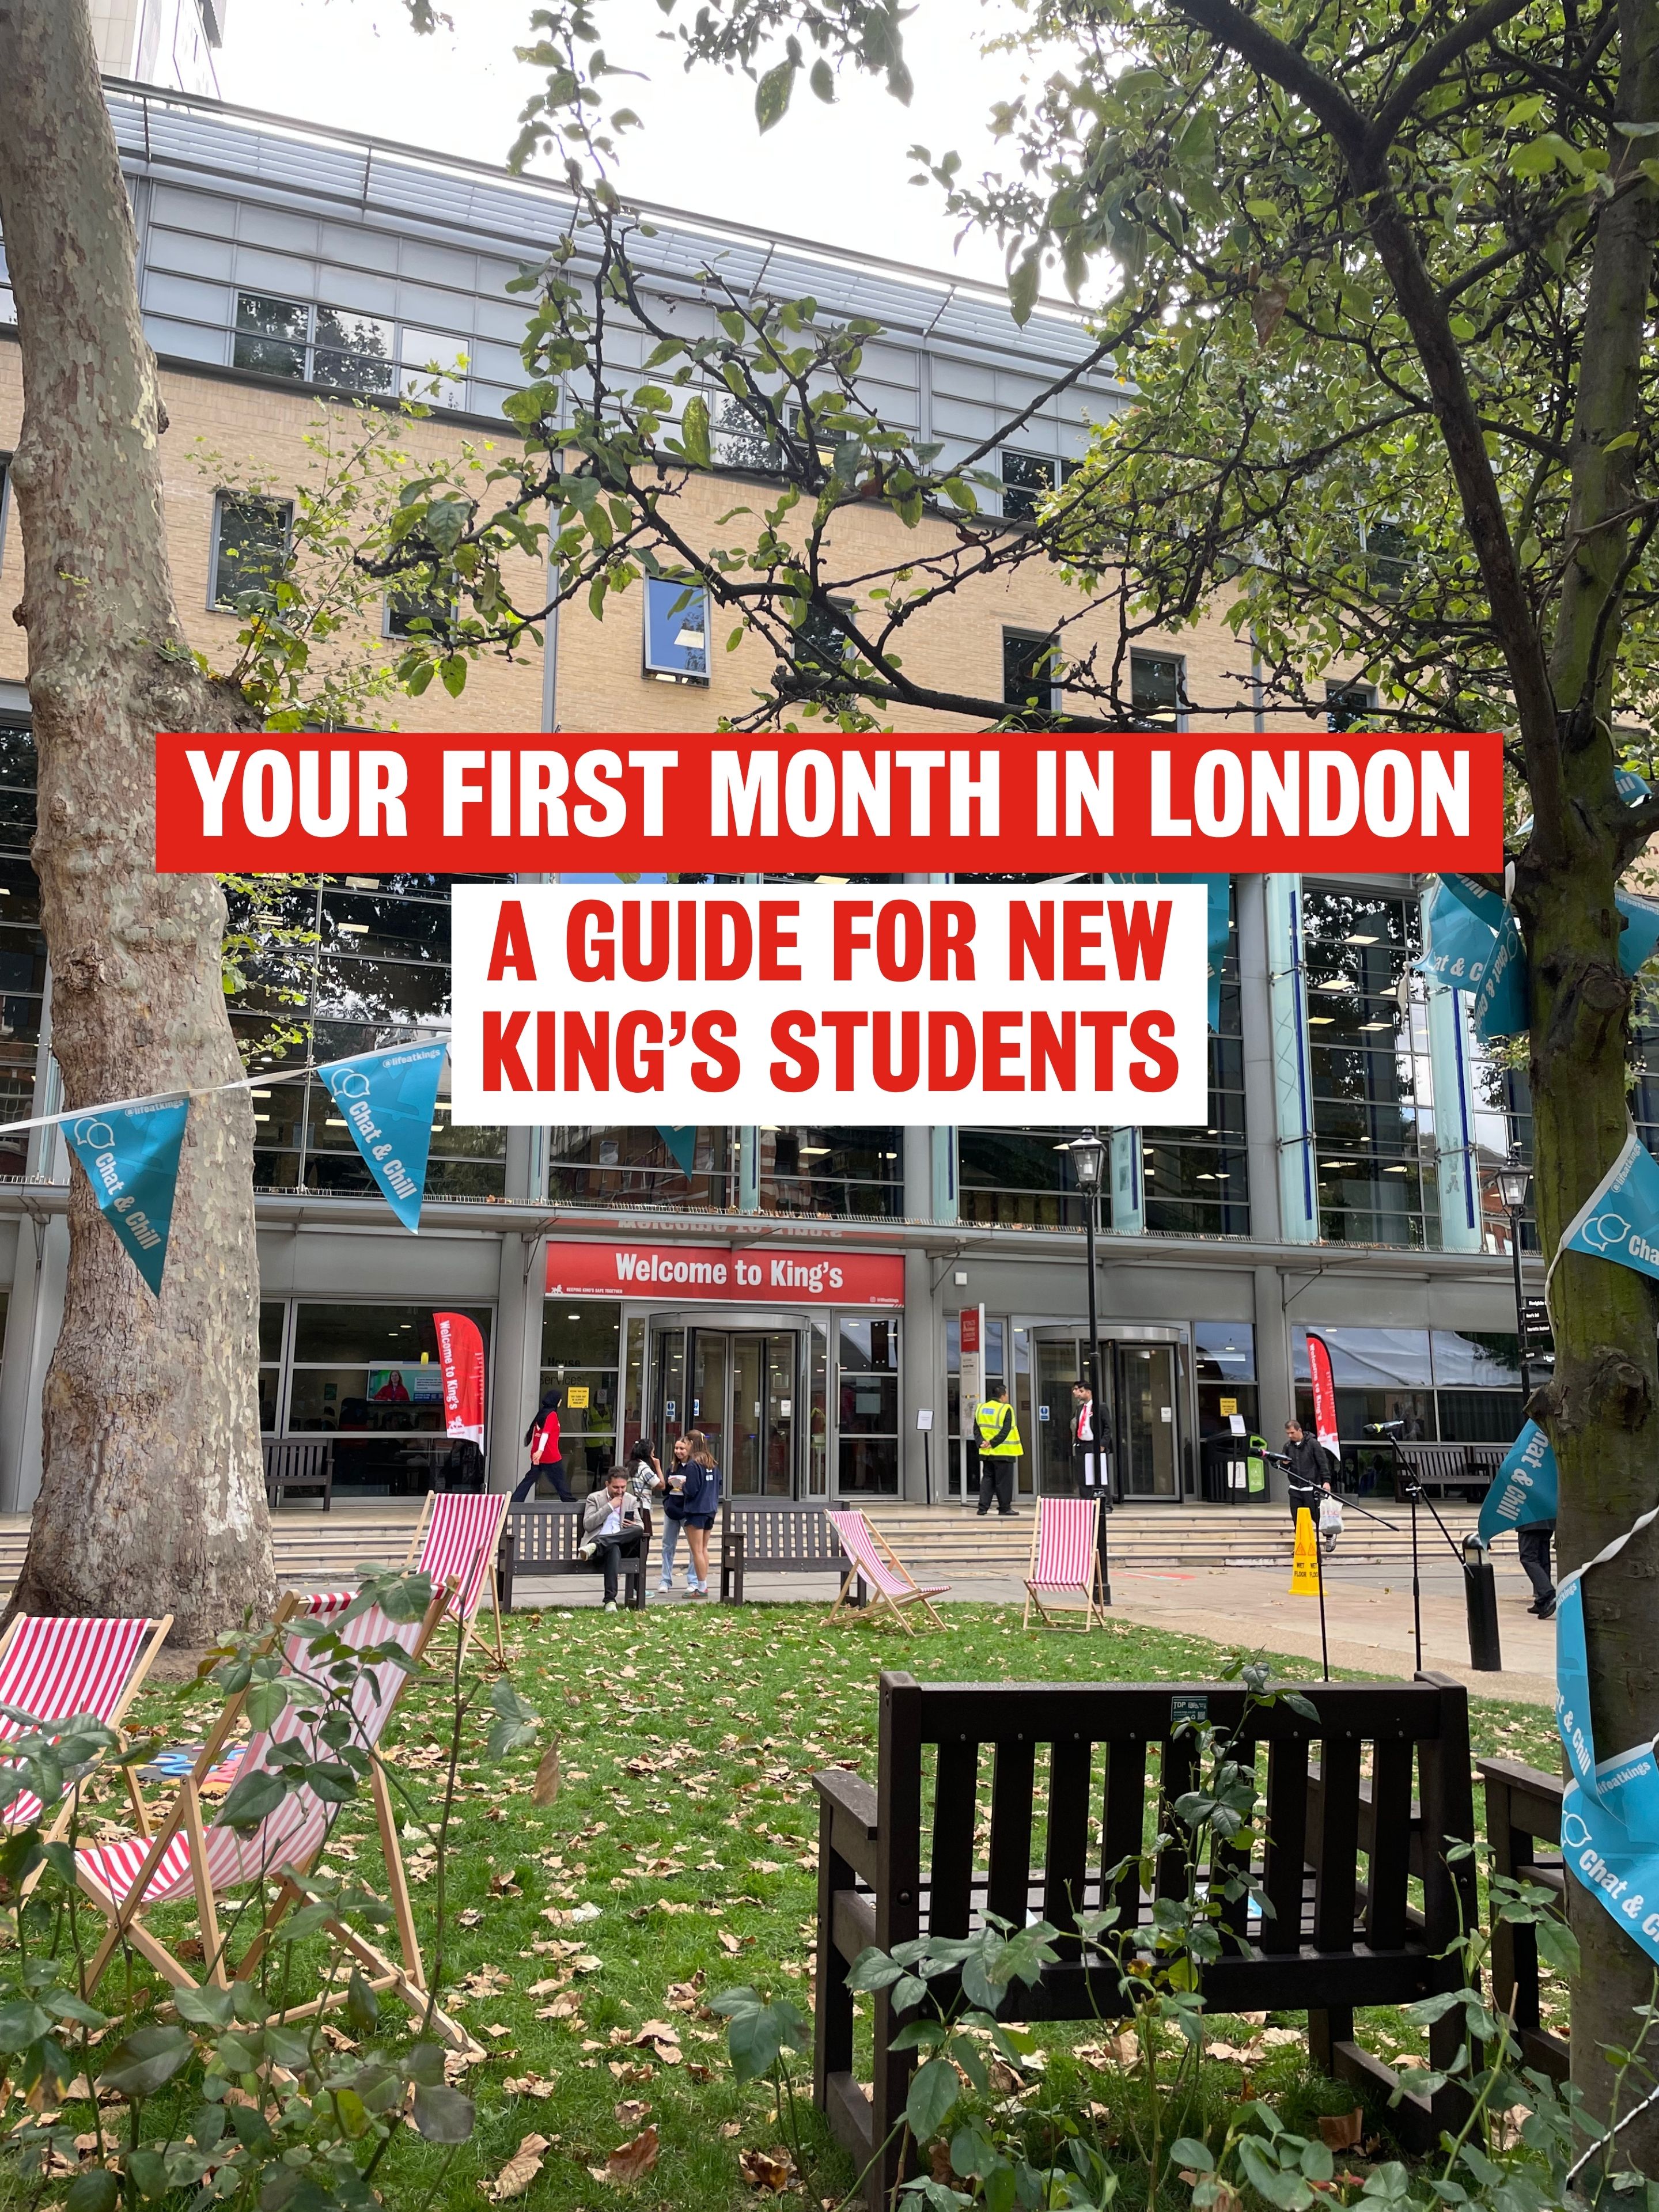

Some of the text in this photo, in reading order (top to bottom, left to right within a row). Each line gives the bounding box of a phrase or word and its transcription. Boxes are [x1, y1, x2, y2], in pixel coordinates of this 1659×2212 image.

[1450, 957, 1465, 977] &
[382, 1050, 441, 1068] @lifeatkings
[124, 1099, 184, 1118] @lifeatkings
[349, 1101, 418, 1200] Chat & Chill
[1611, 1143, 1641, 1193] @lifeatkings
[95, 1152, 162, 1250] Chat & Chill
[615, 1252, 727, 1285] Welcome
[734, 1259, 762, 1286] to
[1628, 1234, 1659, 1266] Cha
[439, 1320, 459, 1411] Welcome to King's
[1309, 1342, 1319, 1381] Welcome
[1315, 1383, 1320, 1393] to
[1495, 1431, 1550, 1521] hat & Chill
[1573, 1728, 1592, 1777] Chill
[1579, 1849, 1628, 1900] Chat
[1622, 1895, 1644, 1919] &
